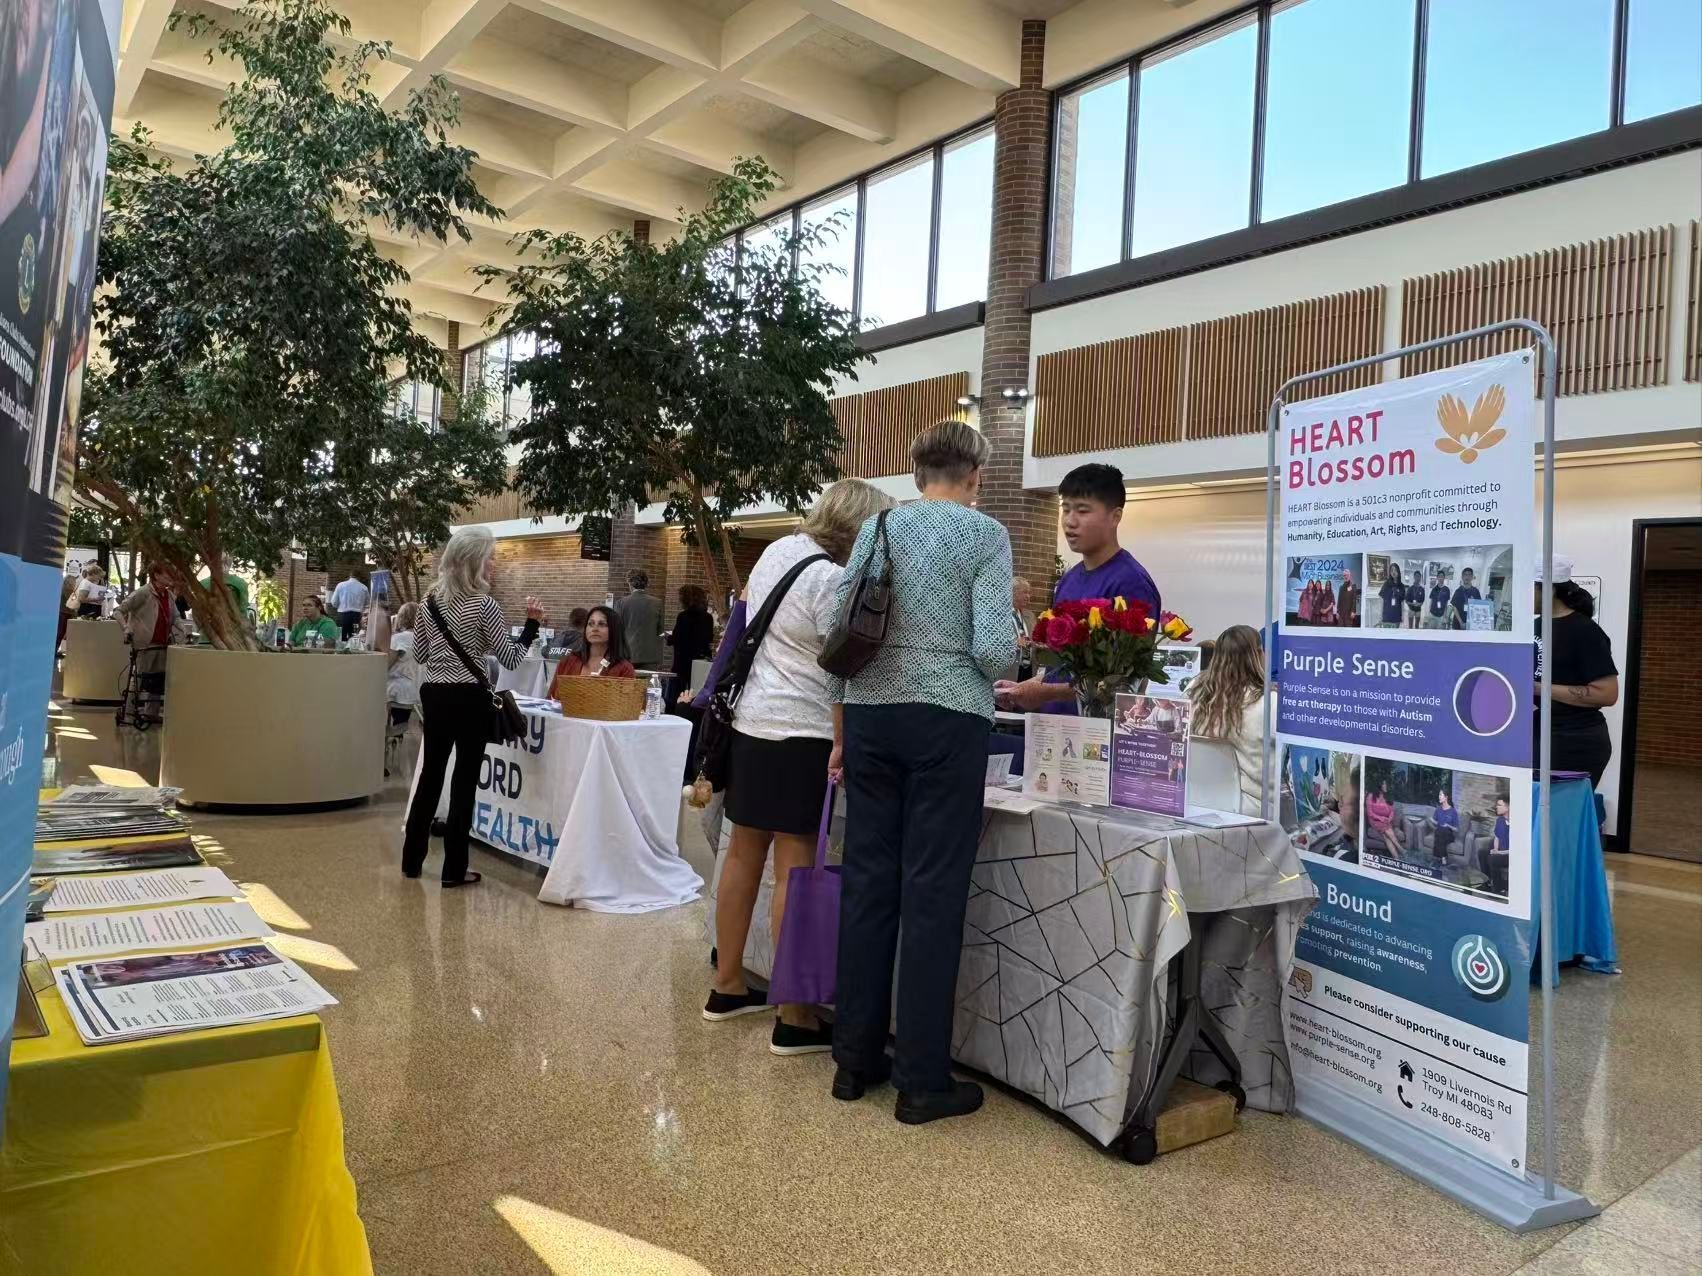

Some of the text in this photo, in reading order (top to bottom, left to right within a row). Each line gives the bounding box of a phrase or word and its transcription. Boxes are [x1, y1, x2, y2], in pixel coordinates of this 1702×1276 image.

[1290, 410, 1384, 456] HEART
[1289, 448, 1415, 489] Blossom
[1287, 499, 1498, 528] empowering individuals and communities through
[1288, 482, 1501, 513] HEART Blossom is a 501c3 nonprofit committed to
[1287, 517, 1502, 542] Humanity, Education, Art, Rights, and Technology.
[1317, 559, 1344, 572] 2024
[548, 647, 573, 655] STAFF
[1283, 649, 1414, 679] Purple Sense
[1282, 696, 1433, 722] free art therapy to those with Autism
[1283, 682, 1441, 706] Purple Sense is on a mission to provide
[1282, 712, 1426, 738] and other developmental disorders.
[471, 800, 559, 860] EALTH
[1327, 882, 1392, 923] Bound
[1322, 912, 1329, 922] is
[1330, 916, 1372, 937] dedicated
[1373, 929, 1384, 940] to
[1385, 935, 1433, 960] advancing
[1346, 935, 1375, 956] raising
[1376, 948, 1428, 974] awareness,
[1333, 948, 1384, 973] prevention.
[1290, 1011, 1382, 1060] www.heart-blossom.org
[1324, 985, 1506, 1066] Please consider supporting our cause
[1290, 1041, 1383, 1094] nfo@heart-blossom.org
[1422, 1067, 1512, 1115] 1909 Livernois Rd
[1422, 1079, 1494, 1120] Troy MI 48083
[1420, 1102, 1492, 1142] 248-808-5828
